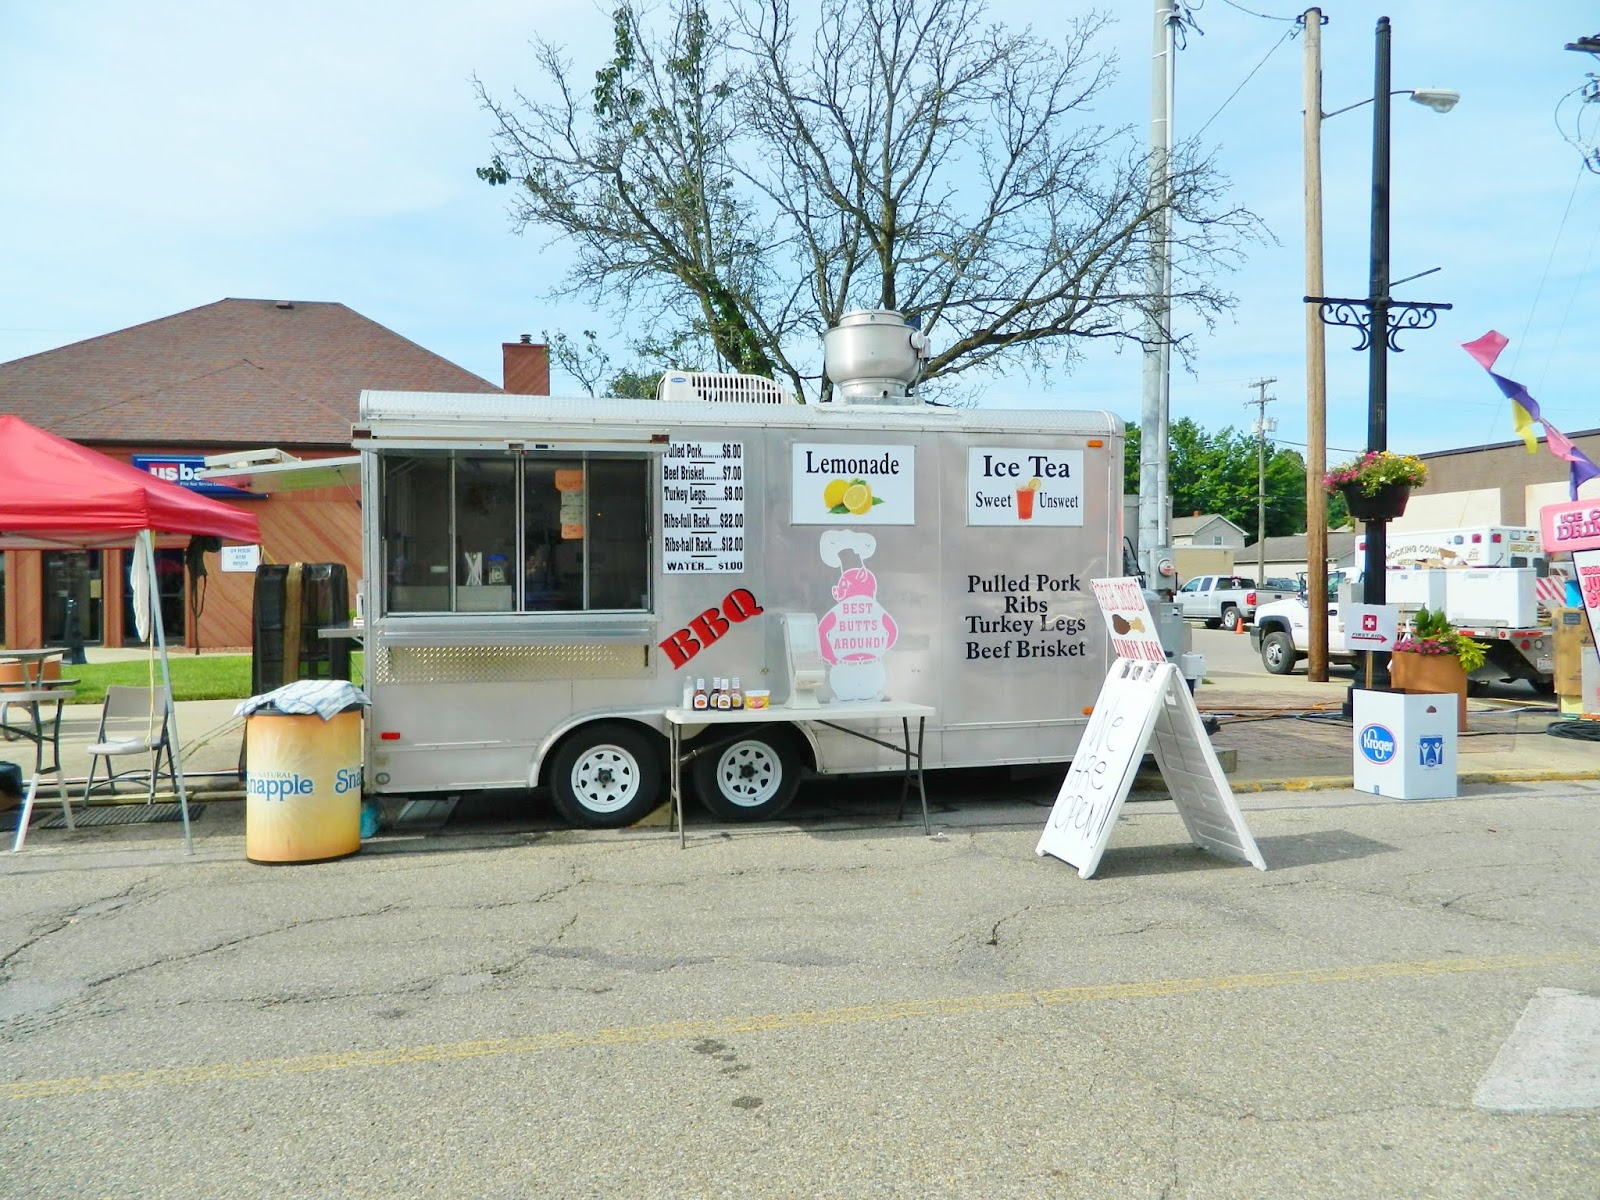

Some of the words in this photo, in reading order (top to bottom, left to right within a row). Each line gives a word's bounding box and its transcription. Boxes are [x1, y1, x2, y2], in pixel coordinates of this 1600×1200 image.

[664, 465, 679, 480] Beef
[805, 451, 900, 475] Lemonade
[983, 455, 1020, 477] Ice
[1028, 455, 1071, 478] Tea
[664, 486, 688, 504] Turkey
[975, 491, 1012, 508] Sweet
[1039, 492, 1079, 508] Unsweet
[1560, 511, 1583, 524] ICE
[967, 574, 1030, 593] Pulled
[1036, 573, 1081, 592] Pork
[842, 602, 873, 615] BEST
[1004, 595, 1048, 614] Ribs
[658, 588, 764, 671] BBQ
[839, 619, 878, 632] BUTTS
[965, 614, 1034, 637] Turkey
[1040, 614, 1086, 635] Legs
[834, 636, 884, 650] AROUND!
[965, 640, 1013, 660] Beef
[1016, 639, 1086, 658] Brisket
[1141, 640, 1166, 662] LEGS
[1363, 728, 1394, 759] Kroger
